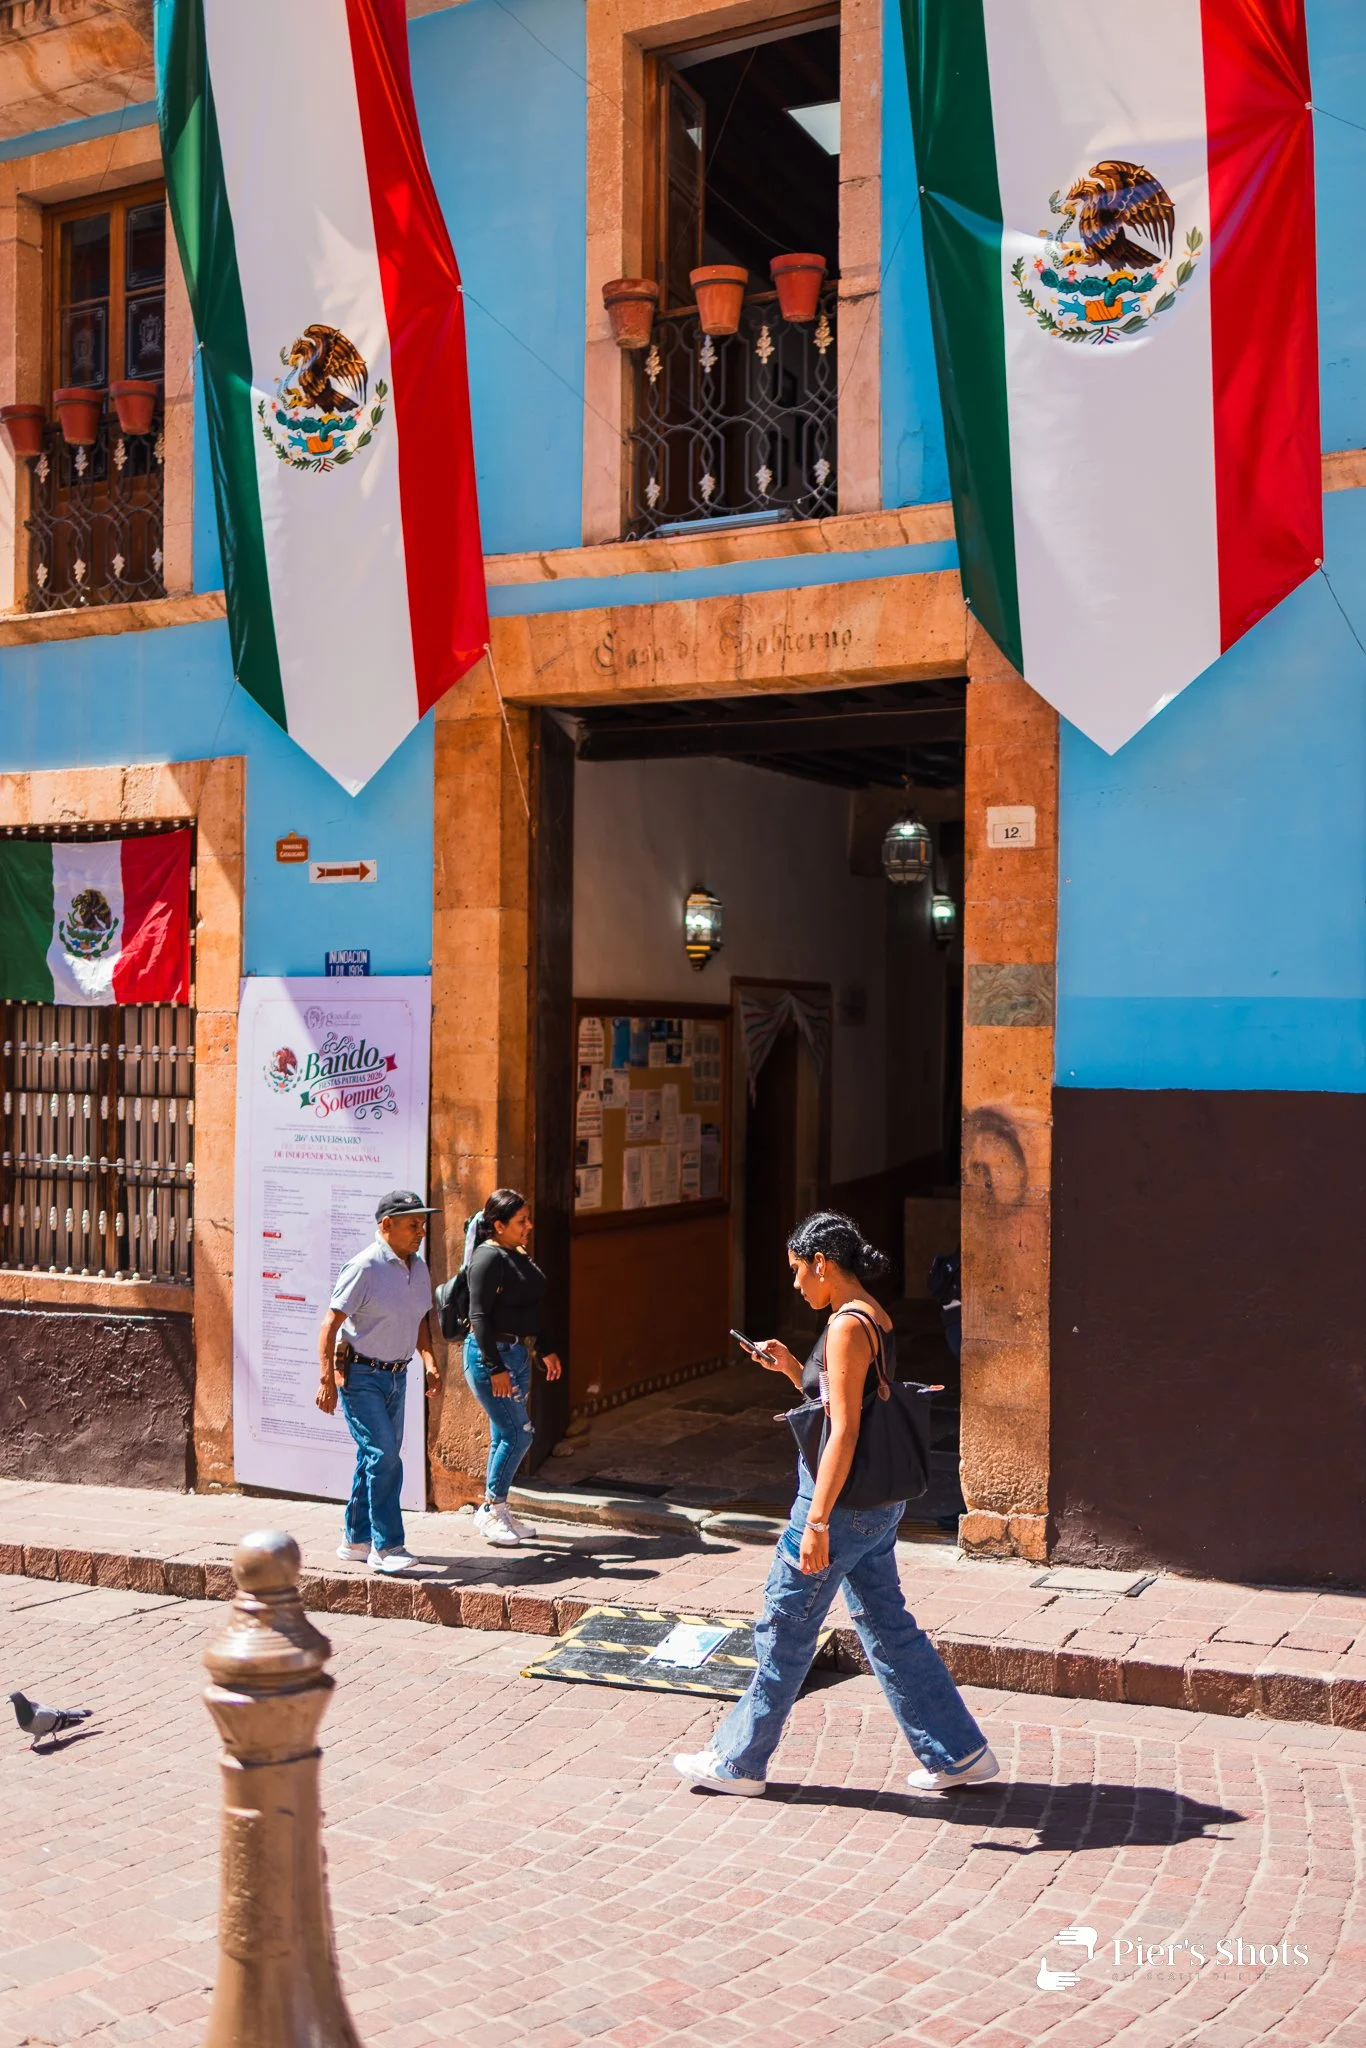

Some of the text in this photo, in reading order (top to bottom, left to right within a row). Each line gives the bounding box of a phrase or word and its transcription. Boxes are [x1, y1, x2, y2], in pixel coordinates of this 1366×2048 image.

[328, 950, 368, 964] INUNDACION
[304, 1038, 380, 1080] Bando
[318, 1077, 341, 1090] FIESTAS
[341, 1074, 366, 1085] PATRIAS
[315, 1085, 385, 1119] Solemne
[309, 1134, 362, 1145] ANIVERSARIO
[274, 1151, 382, 1163] DE INDEPENDENCIA NACIONAL
